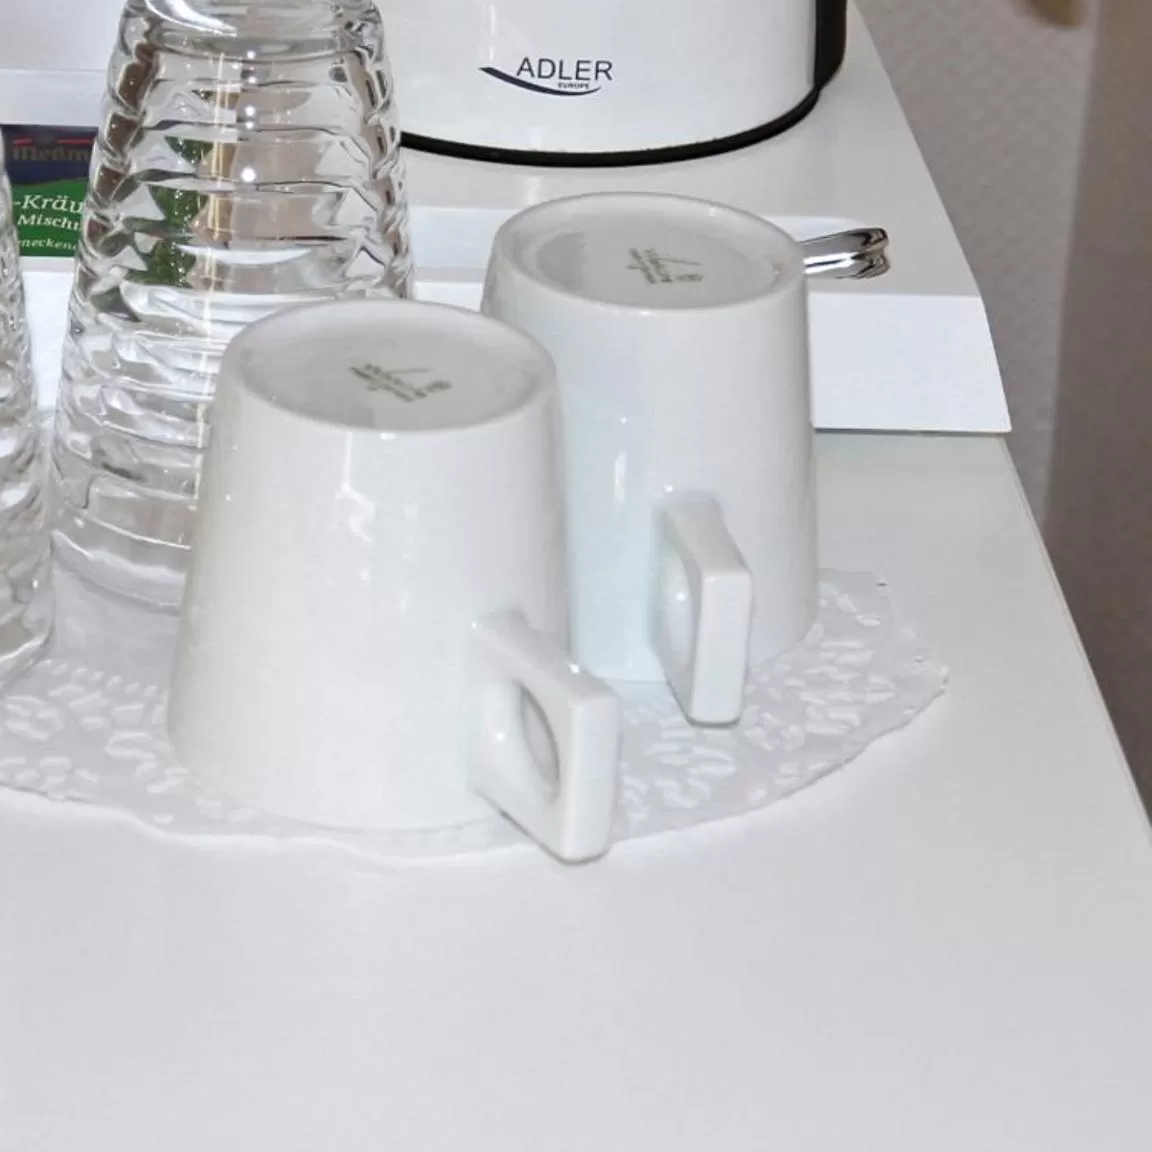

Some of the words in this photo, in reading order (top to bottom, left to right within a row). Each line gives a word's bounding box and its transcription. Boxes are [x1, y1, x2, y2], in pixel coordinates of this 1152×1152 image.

[516, 56, 613, 81] ADLER
[558, 82, 590, 90] EUROPE
[13, 194, 84, 214] -Kräu
